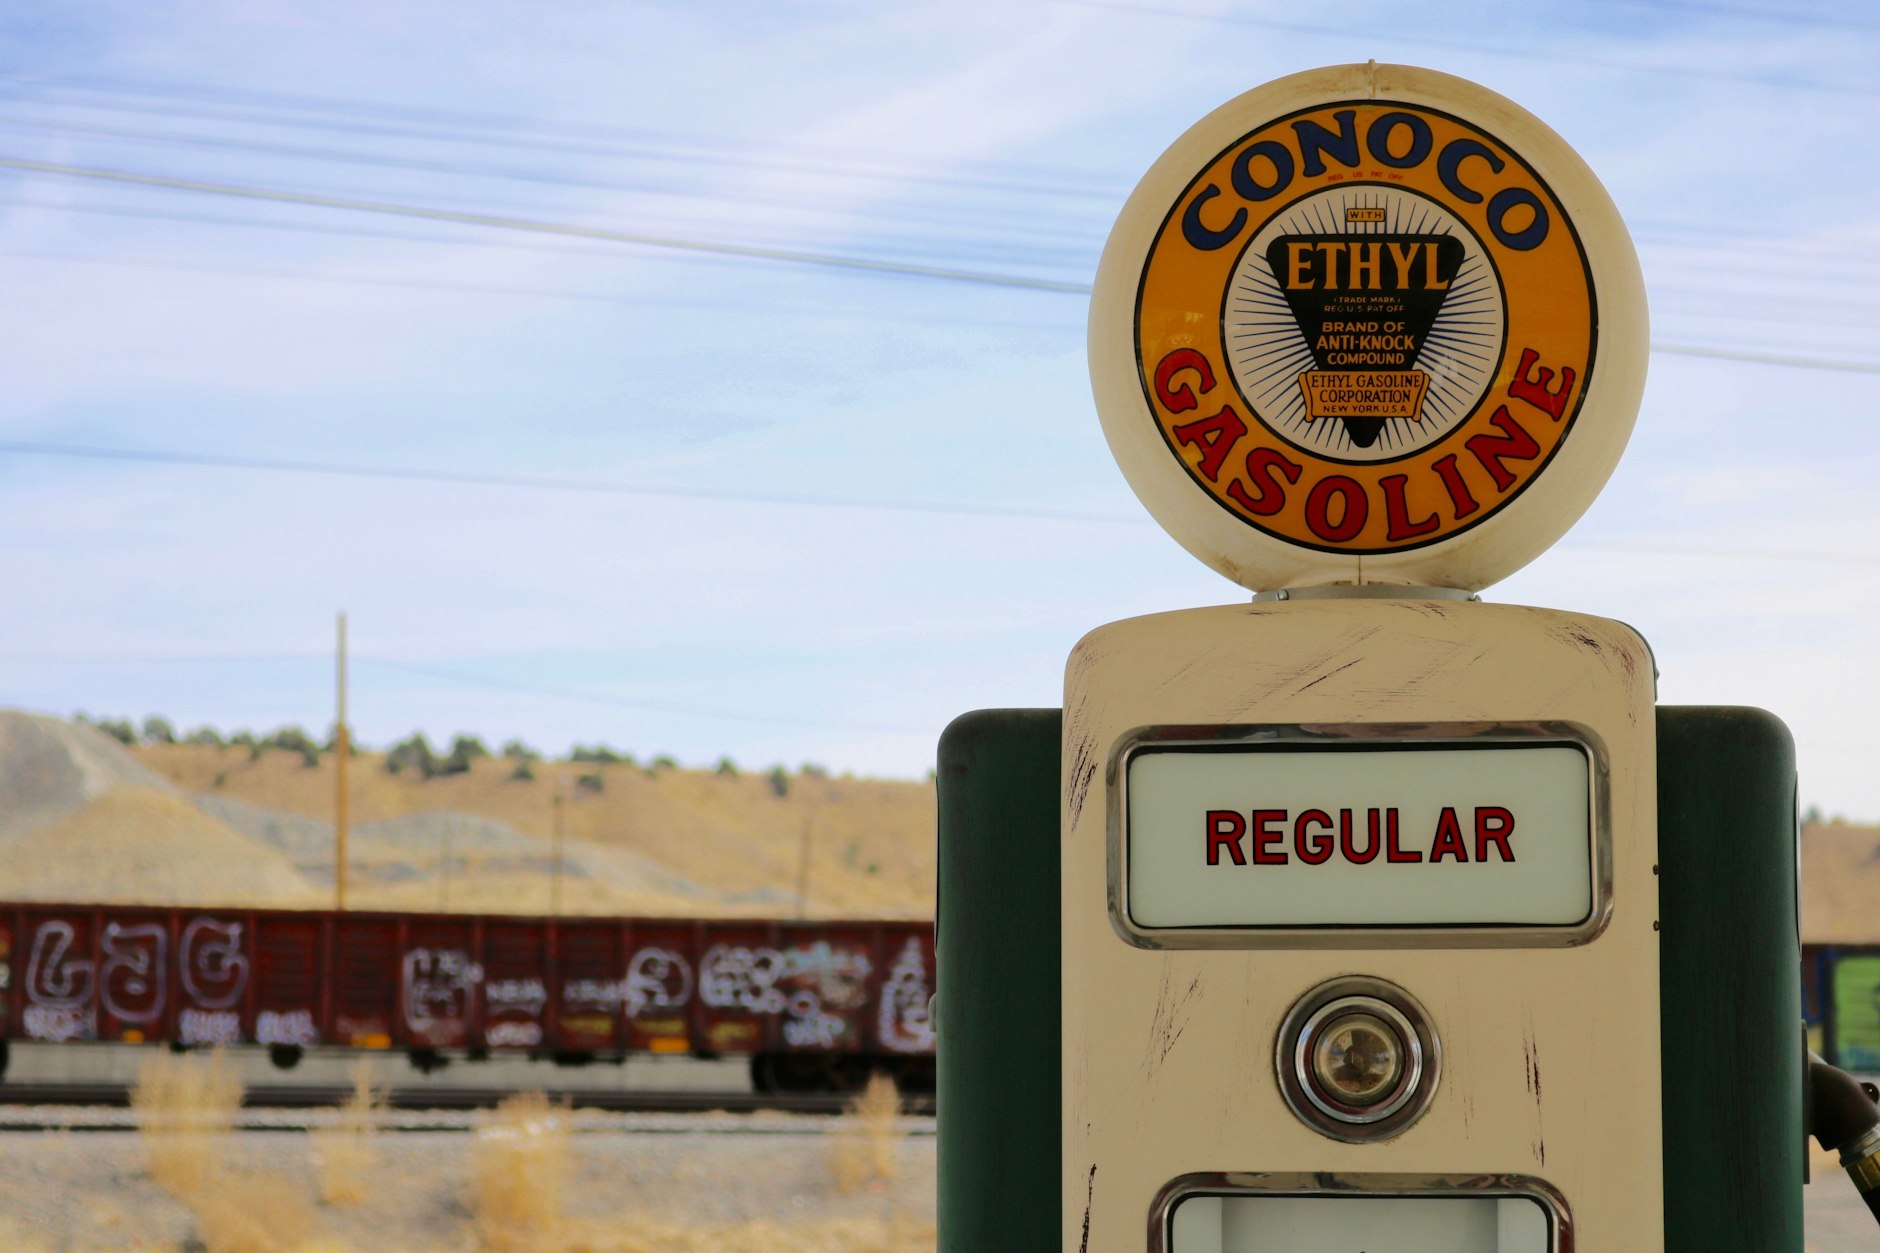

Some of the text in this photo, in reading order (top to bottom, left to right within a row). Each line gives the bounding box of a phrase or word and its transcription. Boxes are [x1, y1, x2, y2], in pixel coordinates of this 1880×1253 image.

[1182, 110, 1549, 251] CONOCO
[1350, 211, 1382, 219] WITH
[1286, 242, 1450, 290] ETHYL
[1322, 321, 1405, 333] BRAND OF
[1316, 334, 1415, 350] ANTI-KNOCK
[1327, 352, 1405, 365] COMPOUND
[1311, 374, 1421, 388] ETHYL GASOLINE
[1319, 389, 1411, 402] CORPORATION
[1323, 405, 1349, 413] NEW
[1352, 405, 1380, 413] YORK
[1154, 348, 1576, 542] GASOLINE
[1206, 807, 1516, 866] REGULAR
